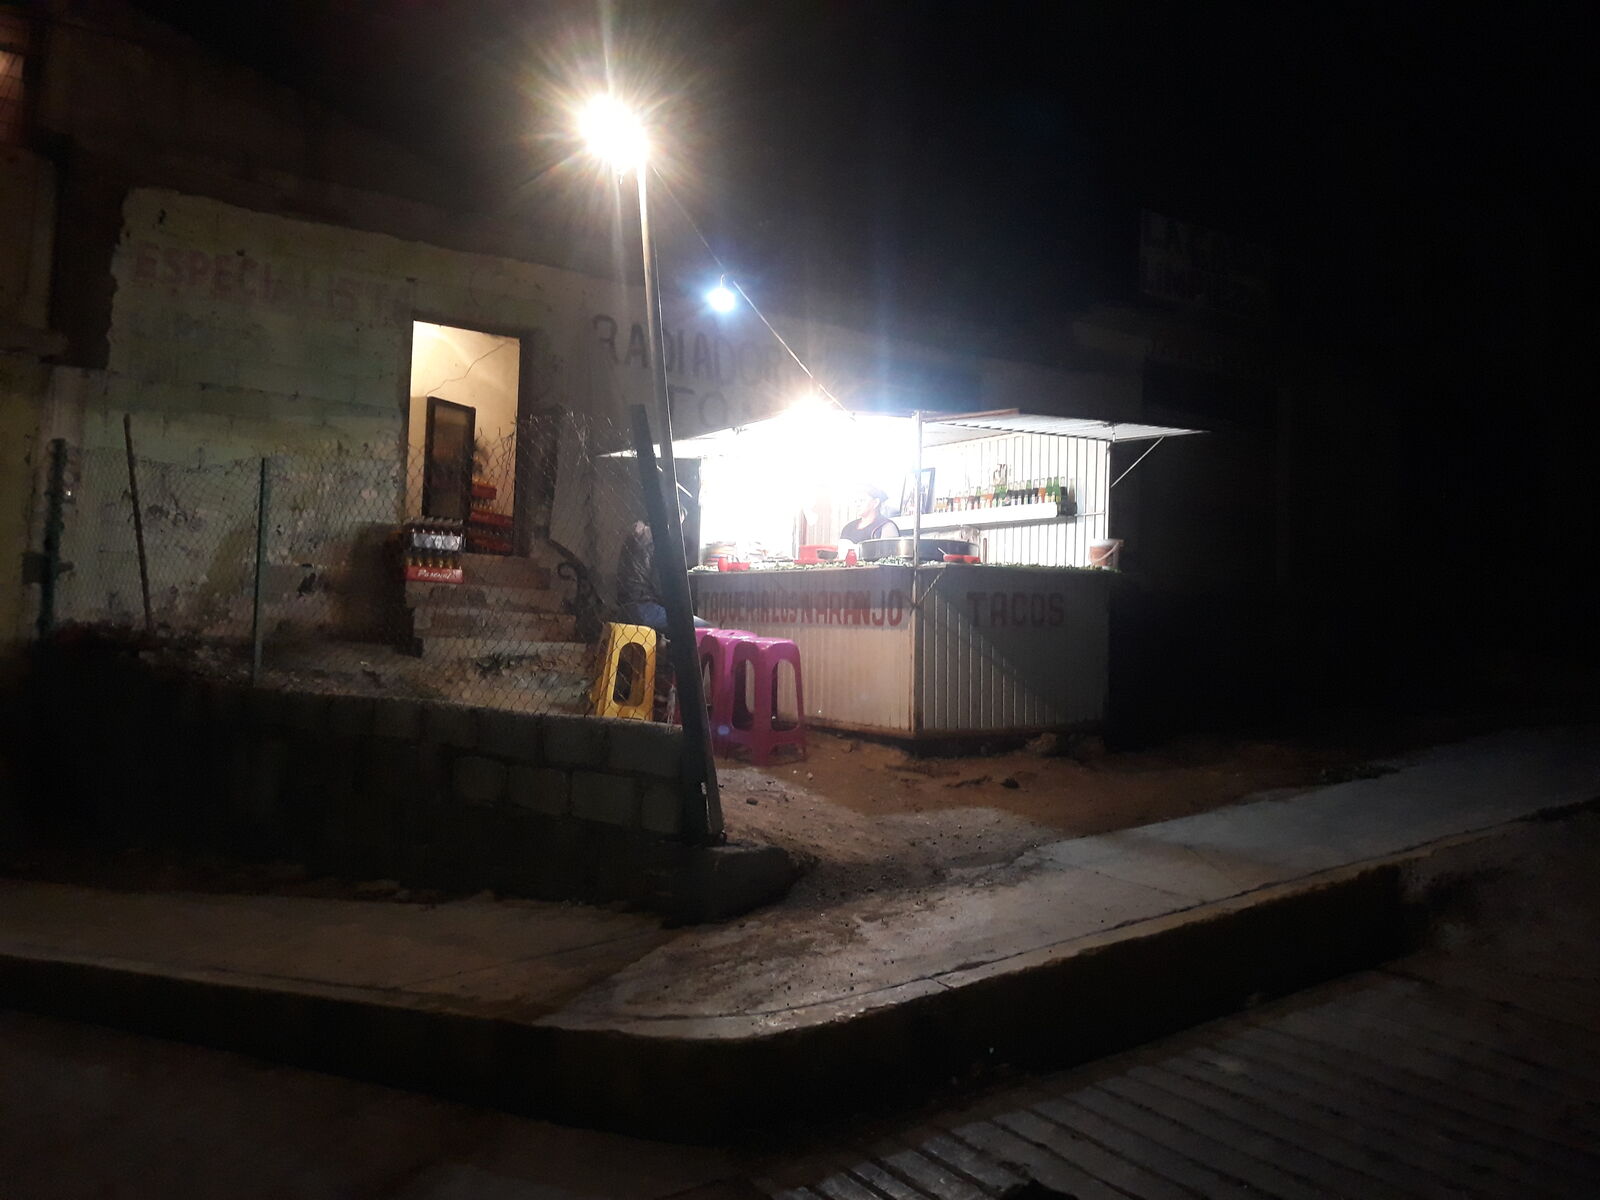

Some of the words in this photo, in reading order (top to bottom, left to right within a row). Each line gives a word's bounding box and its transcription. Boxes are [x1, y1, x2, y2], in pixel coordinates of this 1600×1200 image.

[772, 590, 797, 624] LOS
[801, 588, 903, 627] NARANJO
[966, 591, 1064, 628] TACOS
